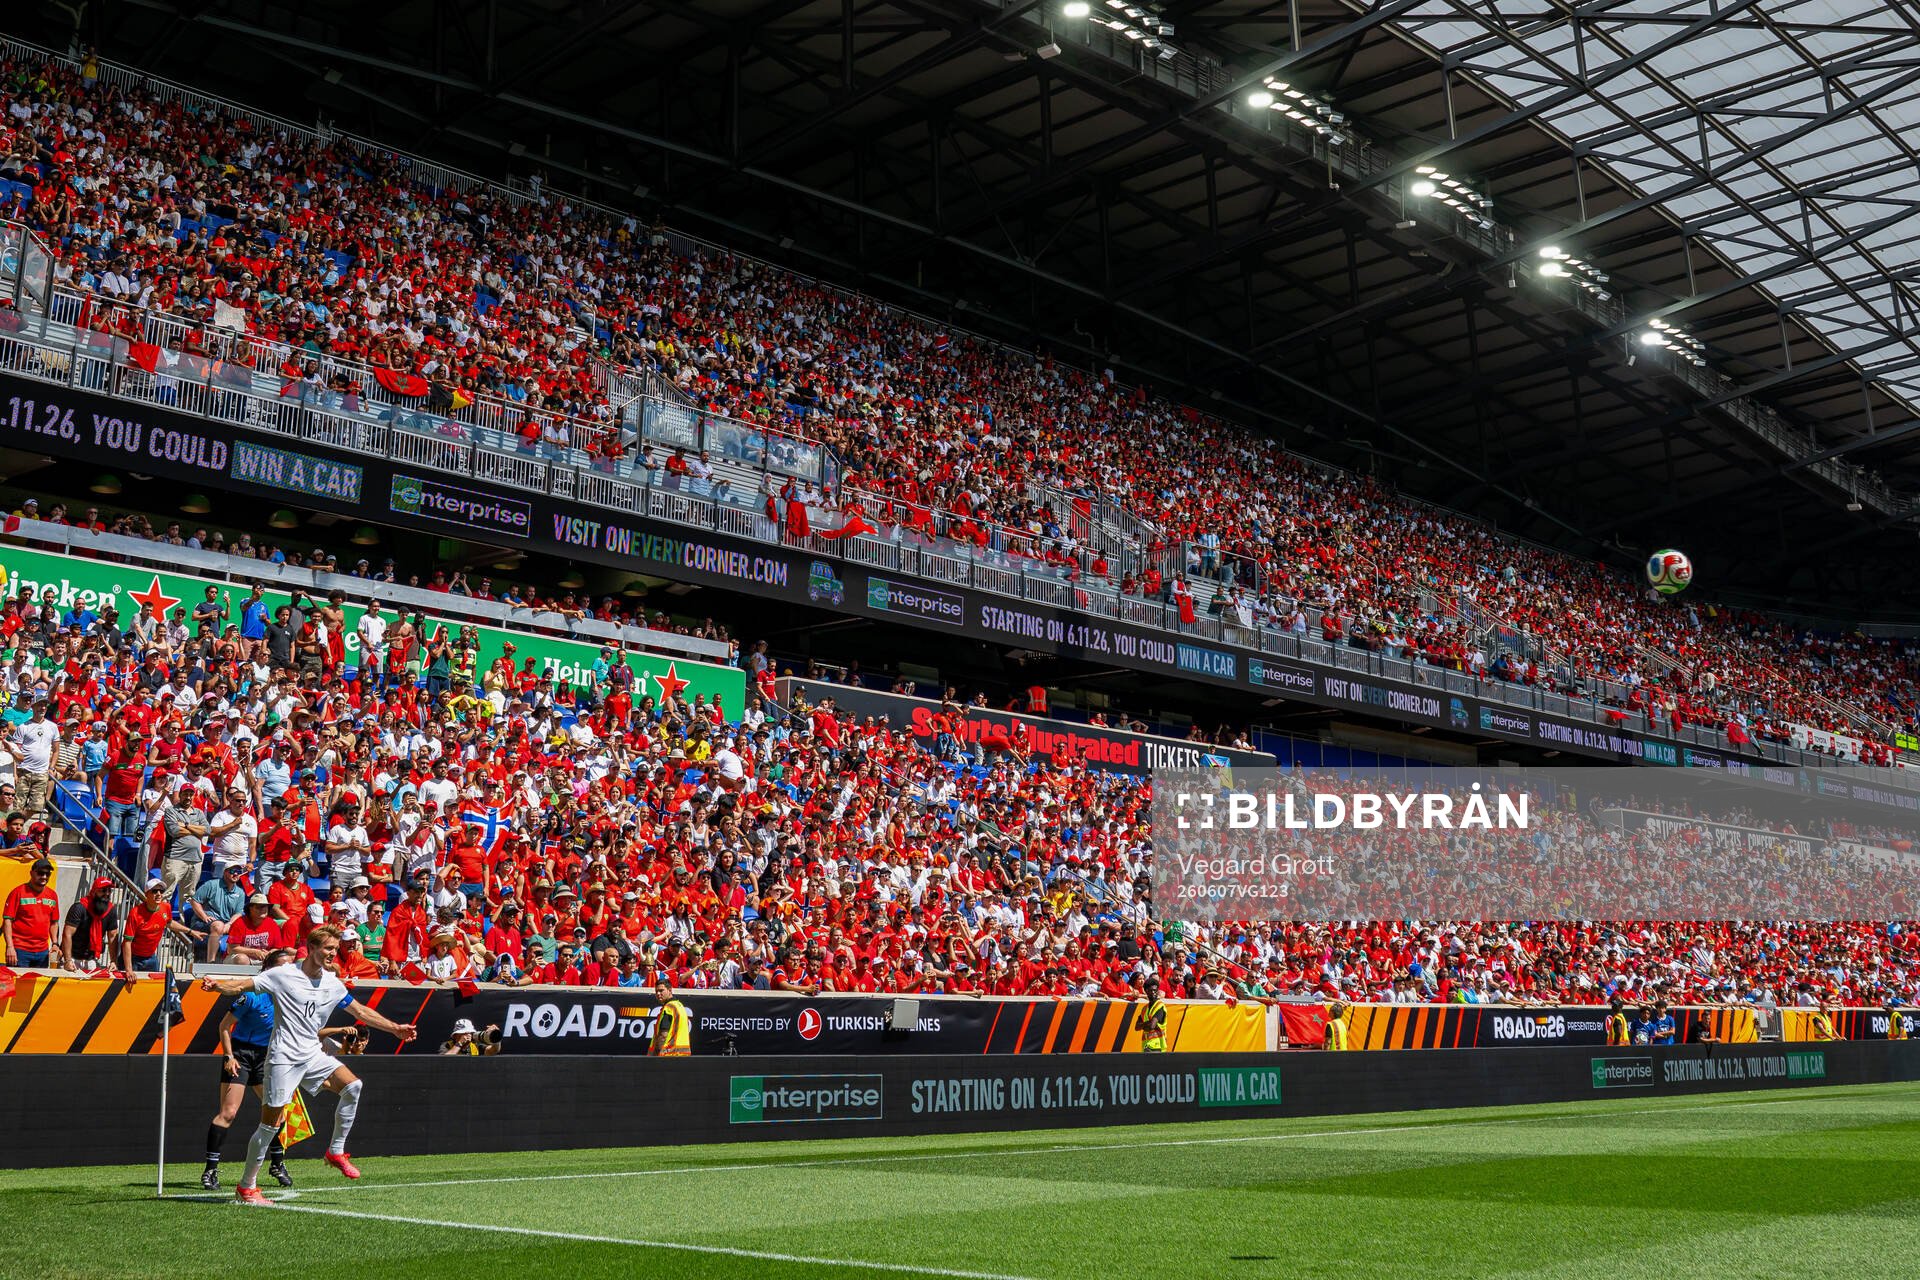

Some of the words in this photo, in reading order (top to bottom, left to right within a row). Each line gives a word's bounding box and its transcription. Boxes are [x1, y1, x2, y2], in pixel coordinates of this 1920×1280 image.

[93, 414, 142, 452] YOU
[149, 428, 227, 470] COULD
[239, 446, 286, 484] WIN
[290, 459, 305, 489] A
[313, 463, 357, 498] CAR
[399, 486, 528, 527] enterprise
[553, 514, 601, 548] VISIT
[605, 525, 788, 587] ONEVERYCORNER.COM
[874, 587, 962, 616] enterprise
[981, 606, 1043, 639] STARTING
[1047, 620, 1064, 643] ON
[1067, 624, 1111, 655] 6.11.26,
[1113, 633, 1136, 656] YOU
[1140, 639, 1175, 664] COULD
[1179, 647, 1200, 670] WIN
[1203, 652, 1211, 671] A
[1213, 654, 1234, 676] CAR
[1253, 665, 1313, 688] enterprise
[1324, 677, 1348, 699] VISIT
[1350, 682, 1440, 718] ONEVERYCORNER.COM
[1484, 712, 1529, 732] enterprise
[1539, 722, 1572, 743] STARTING
[1574, 729, 1583, 745] ON
[1608, 737, 1622, 753] YOU
[1623, 740, 1642, 757] COULD
[1644, 743, 1657, 760] WIN
[1658, 746, 1663, 761] A
[1664, 747, 1676, 763] CAR
[1145, 742, 1200, 775] TICKETS
[1686, 753, 1721, 770] enterprise
[304, 1001, 315, 1018] 10
[503, 1004, 616, 1038] ROAD
[617, 1019, 646, 1038] TO
[701, 1017, 774, 1031] PRESENTED
[775, 1018, 791, 1031] BY
[827, 1016, 884, 1031] TURKISH
[1493, 1016, 1536, 1039] ROAD
[1536, 1025, 1547, 1038] TO
[1547, 1016, 1565, 1038] 26
[1567, 1021, 1596, 1031] PRESENTED
[1597, 1023, 1603, 1031] BY
[1597, 1062, 1652, 1082] enterprise
[1664, 1058, 1703, 1082] STARTING
[1704, 1058, 1716, 1080] ON
[1717, 1058, 1746, 1081] 6.11.26,
[1746, 1057, 1761, 1077] YOU
[1763, 1056, 1786, 1076] COULD
[1788, 1055, 1802, 1076] WIN
[1803, 1055, 1810, 1075] A
[1811, 1055, 1824, 1075] CAR
[740, 1083, 880, 1113] enterprise
[911, 1078, 1004, 1113] STARTING
[1011, 1078, 1035, 1109] ON
[1041, 1076, 1104, 1110] 6.11.26,
[1109, 1074, 1140, 1105] YOU
[1146, 1073, 1195, 1104] COULD
[1202, 1073, 1231, 1102] WIN
[1235, 1072, 1246, 1101] A
[1250, 1072, 1278, 1100] CAR
